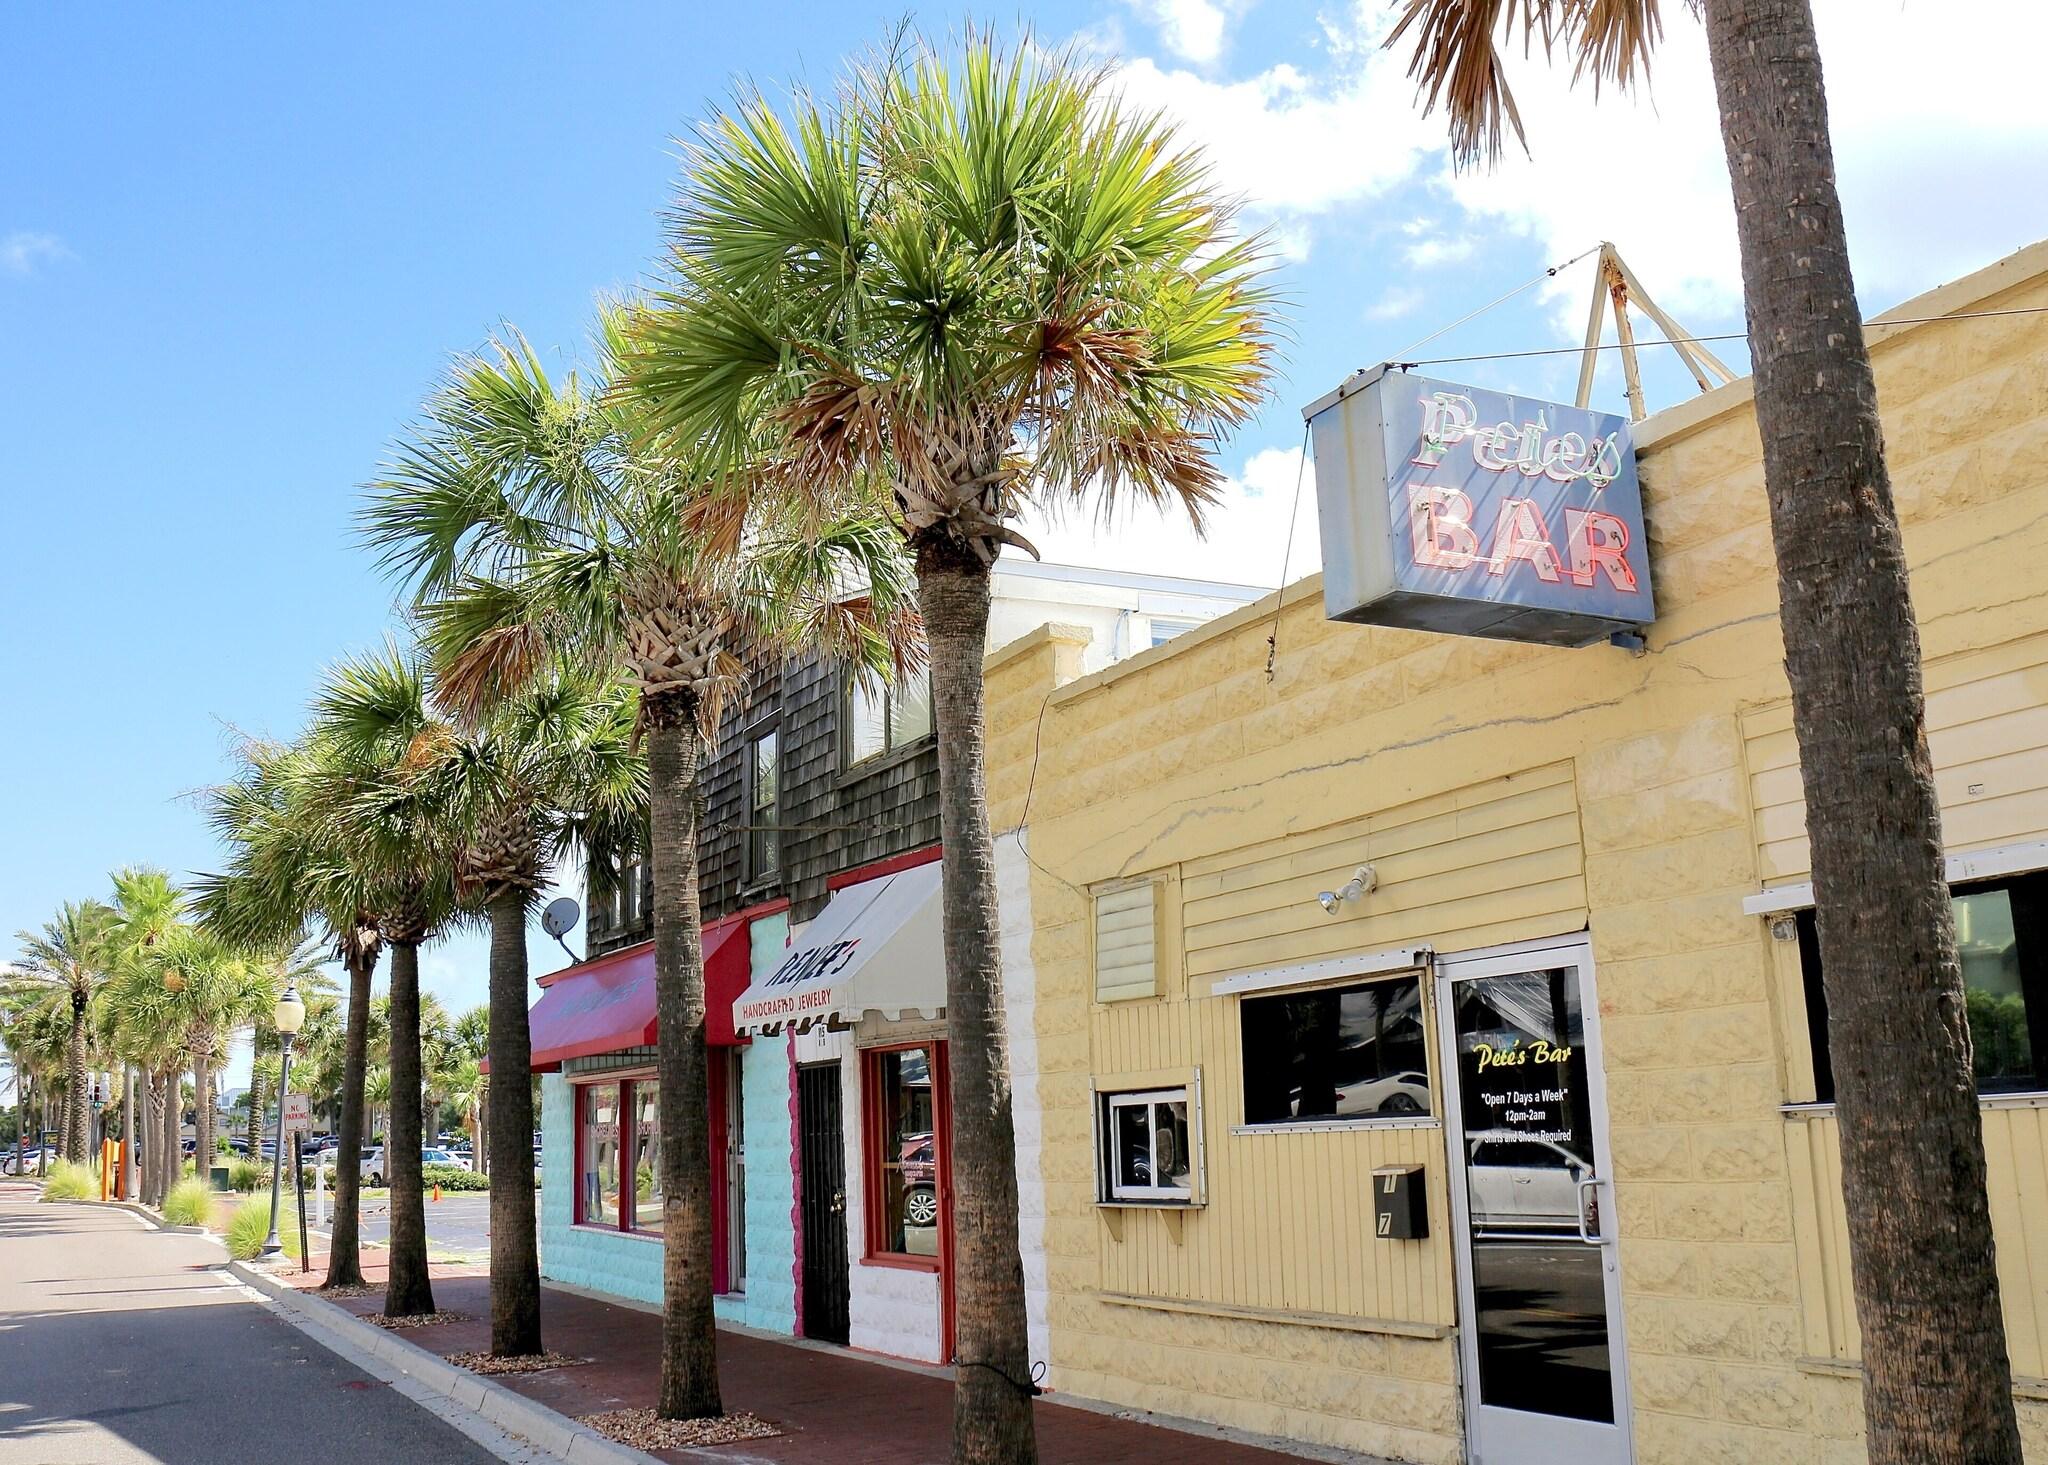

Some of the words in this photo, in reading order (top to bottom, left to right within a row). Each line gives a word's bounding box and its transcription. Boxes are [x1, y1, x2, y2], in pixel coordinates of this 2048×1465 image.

[1407, 484, 1638, 593] BAR
[764, 938, 861, 987] RENEE'S
[798, 988, 833, 1011] JEWELRY
[1473, 1039, 1526, 1074] Pete's
[1527, 1040, 1572, 1064] Bar
[1506, 1091, 1512, 1104] 7
[1514, 1091, 1533, 1106] Days
[1534, 1092, 1541, 1103] a
[286, 1112, 307, 1120] PARKING
[1504, 1108, 1547, 1124] 12pm-2am
[1540, 1128, 1572, 1144] Required
